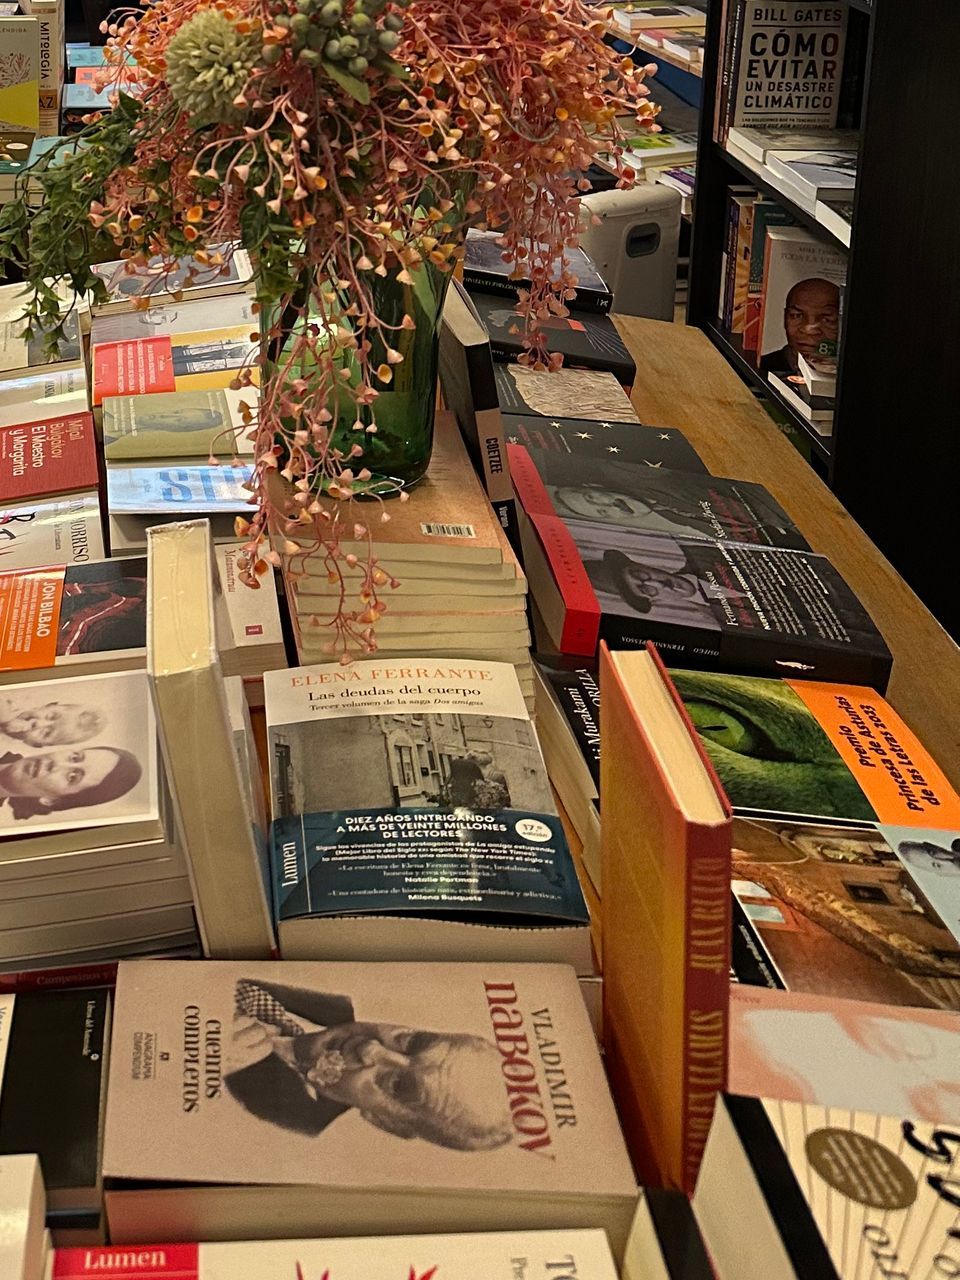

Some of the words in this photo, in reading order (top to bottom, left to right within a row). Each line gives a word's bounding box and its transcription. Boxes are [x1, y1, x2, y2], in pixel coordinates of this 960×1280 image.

[754, 8, 787, 21] BILL
[794, 9, 842, 22] GATES
[40, 21, 53, 80] MITOLOGÍA
[749, 29, 839, 57] CÓMO
[747, 59, 837, 79] EVITAR
[743, 92, 833, 109] CLIMÁTICO
[745, 81, 762, 92] UN
[767, 81, 835, 93] DESASTRE
[8, 435, 27, 476] Margarita
[31, 434, 45, 467] Maestro
[49, 422, 64, 458] Bulgákov
[485, 437, 503, 475] COETZEE
[41, 580, 54, 601] JON
[36, 602, 52, 638] BILBAO
[718, 590, 739, 627] Fernando
[290, 671, 362, 688] ELENA
[371, 668, 494, 682] FERRANTE
[307, 691, 336, 702] Las
[340, 686, 394, 698] deudas
[399, 684, 423, 696] del
[428, 686, 481, 698] cuerpo
[308, 703, 340, 712] Tercer
[341, 700, 381, 708] volumen
[383, 698, 394, 706] de
[451, 699, 484, 707] amigas
[572, 687, 601, 743] Murakami
[838, 695, 877, 742] Asturias
[839, 726, 875, 768] Premio
[884, 758, 924, 811] Princesa
[345, 816, 373, 825] DIEZ
[375, 814, 412, 822] AÑOS
[414, 814, 495, 823] INTRIGANDO
[348, 823, 377, 833] MÁS
[379, 823, 396, 831] DE
[397, 822, 444, 830] VEINTE
[444, 822, 508, 832] MILLONES
[382, 831, 399, 839] DE
[401, 830, 463, 838] LECTORES
[281, 841, 299, 888] Lumen
[132, 1031, 141, 1081] COMPENDIUM
[144, 1031, 153, 1080] ANAGRAMA
[529, 1007, 578, 1129] VLADIMIR
[84, 1249, 167, 1270] Lumen
